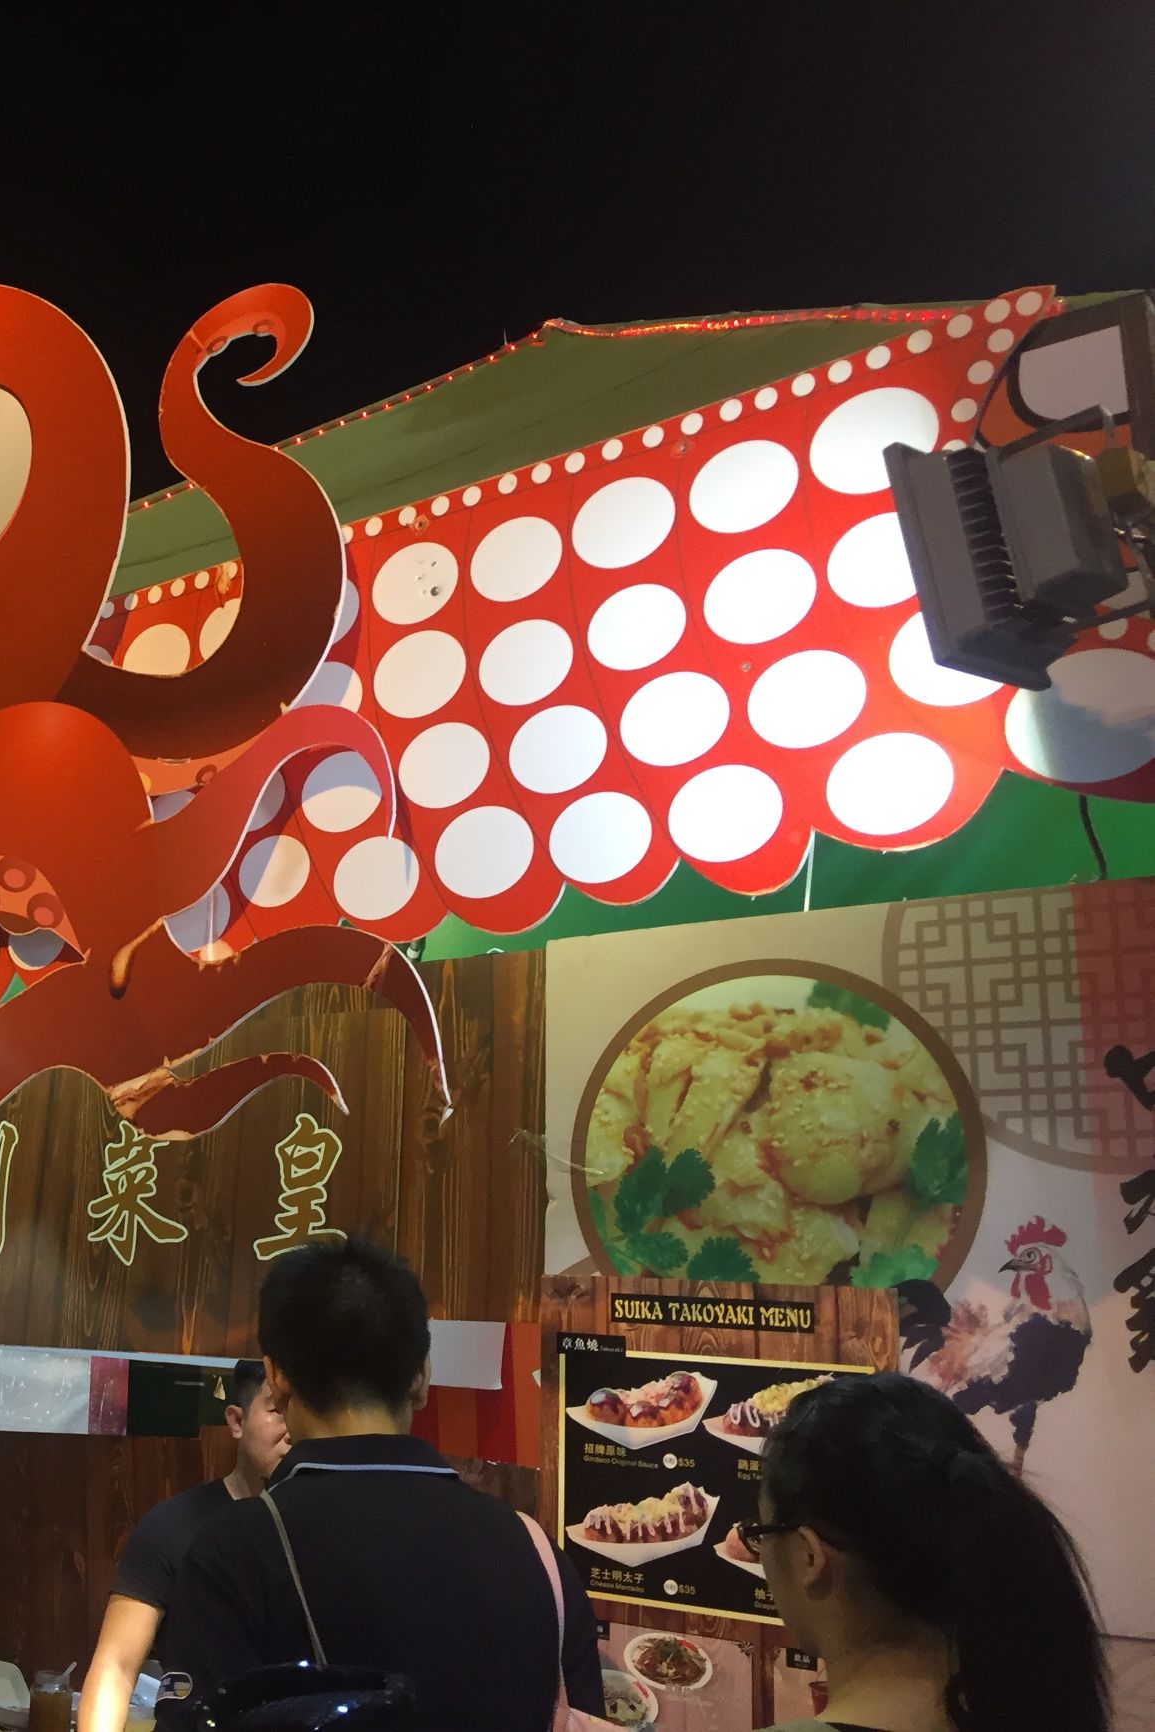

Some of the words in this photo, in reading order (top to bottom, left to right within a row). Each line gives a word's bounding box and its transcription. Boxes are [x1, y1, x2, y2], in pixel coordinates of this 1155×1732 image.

[614, 1299, 663, 1321] SUIKA
[668, 1302, 754, 1326] TAKOYAKI
[759, 1306, 812, 1329] MENU
[562, 1337, 598, 1352] 章魚燒
[677, 1457, 695, 1468] $35
[590, 1567, 644, 1583] 芝士明太子
[678, 1584, 696, 1596] $35
